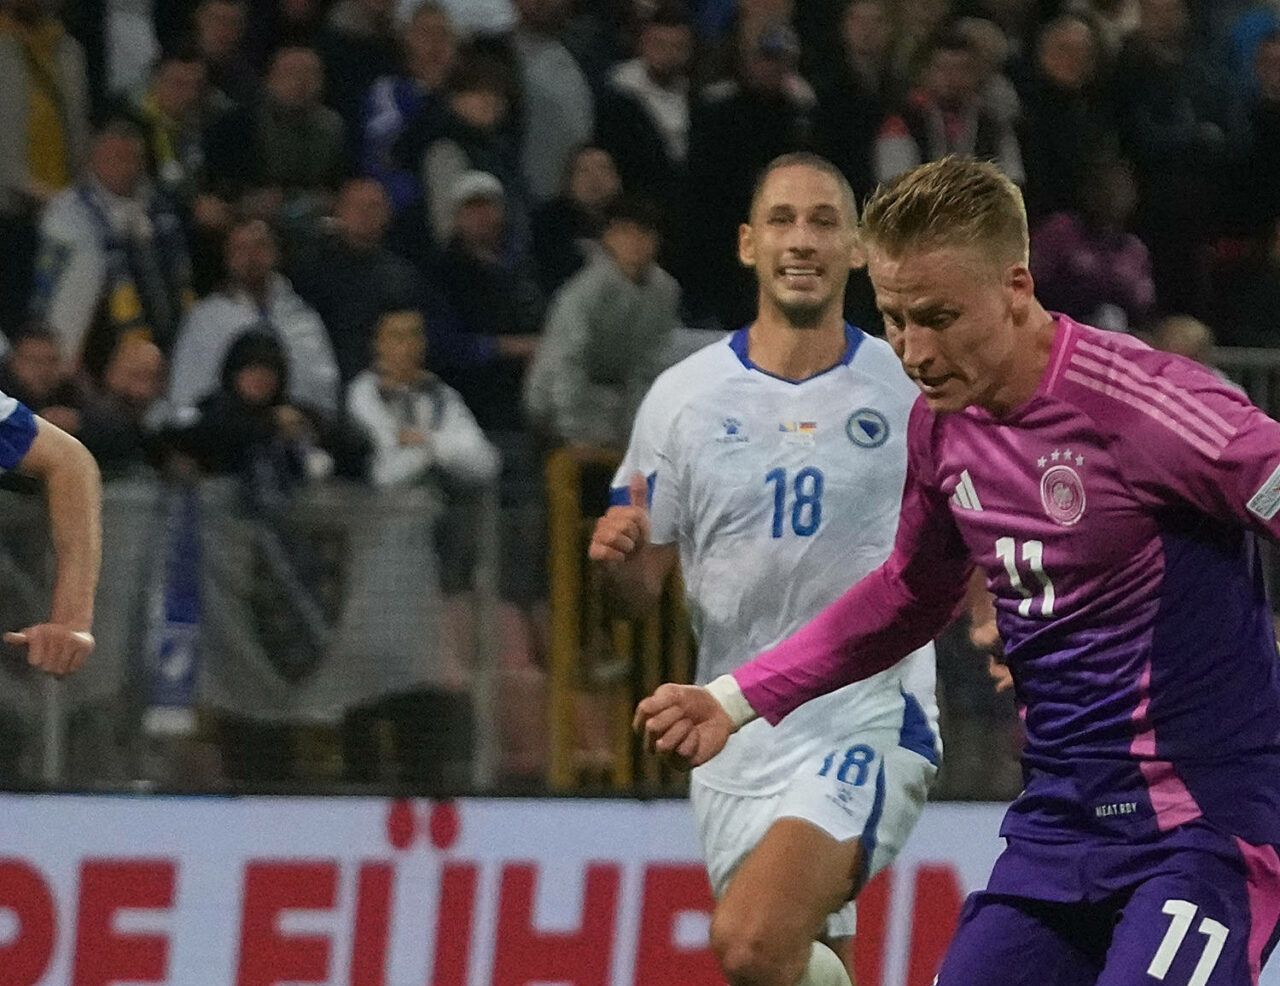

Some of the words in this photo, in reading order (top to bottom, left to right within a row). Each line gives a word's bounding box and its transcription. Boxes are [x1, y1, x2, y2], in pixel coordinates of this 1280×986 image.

[765, 466, 824, 539] 18
[995, 536, 1055, 618] 11
[817, 743, 875, 787] 18
